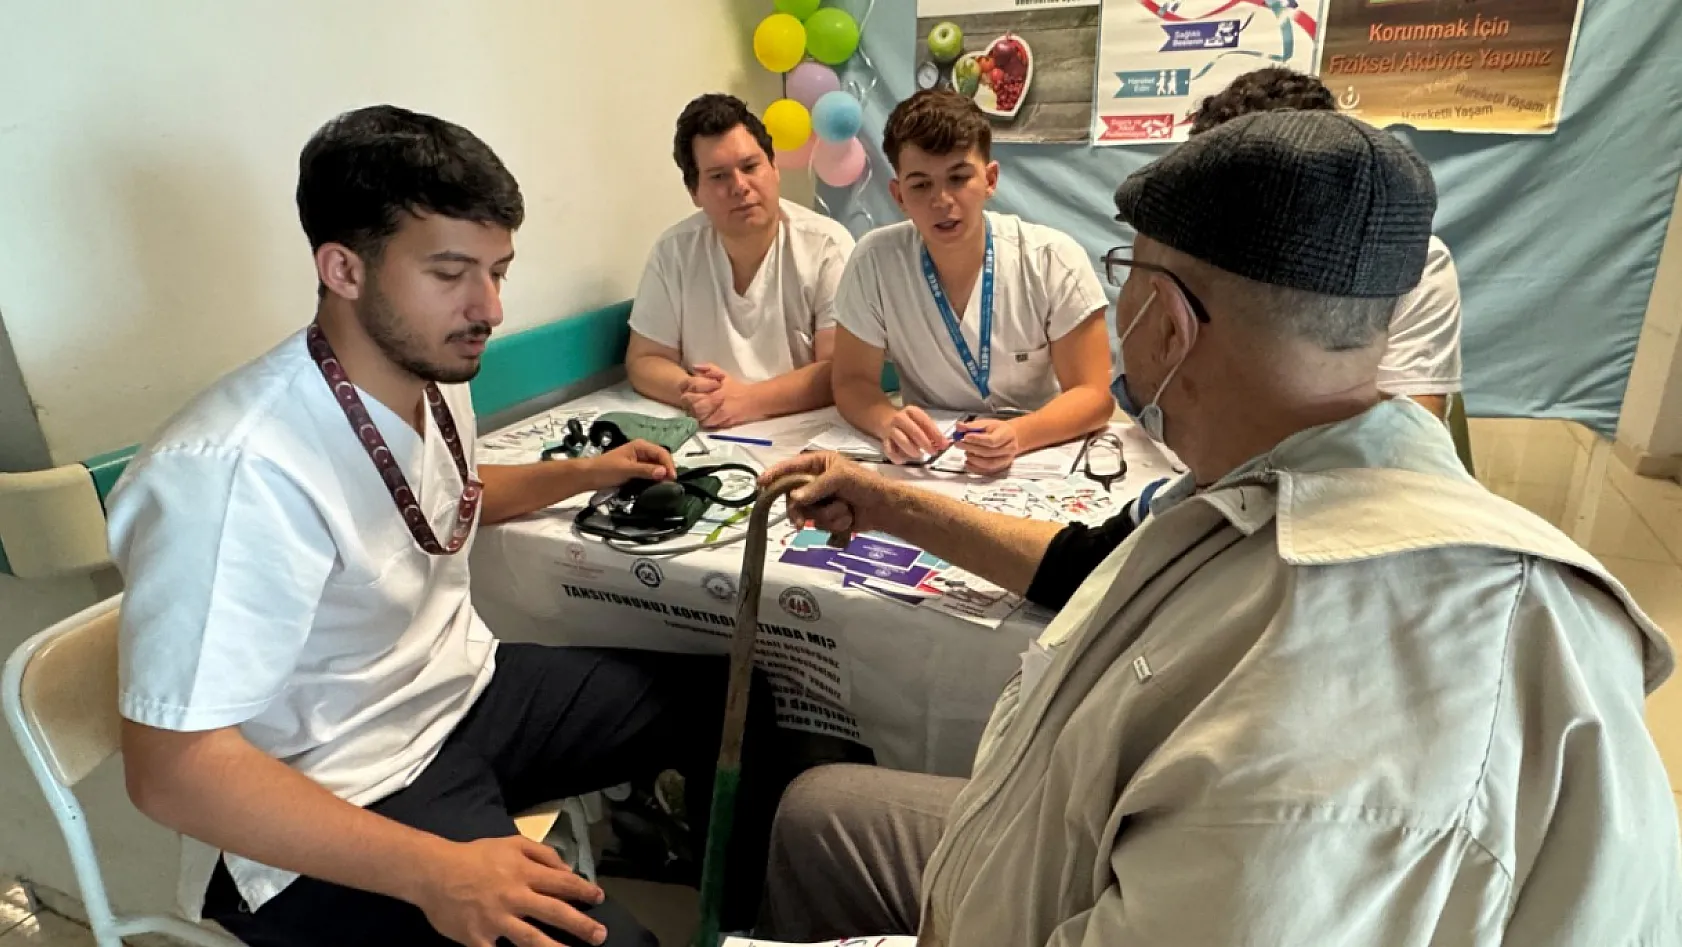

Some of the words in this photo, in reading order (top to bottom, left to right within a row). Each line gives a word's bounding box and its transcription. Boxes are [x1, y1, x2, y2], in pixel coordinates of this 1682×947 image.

[1369, 19, 1469, 42] Korunmak
[1474, 13, 1510, 41] İçin
[1329, 53, 1397, 74] Fiziksel
[1400, 51, 1474, 72] Aktivite
[1477, 48, 1553, 72] Yapınız
[1454, 104, 1493, 119] Yaşam
[1507, 94, 1546, 113] Yaşam
[756, 623, 805, 641] TINDA
